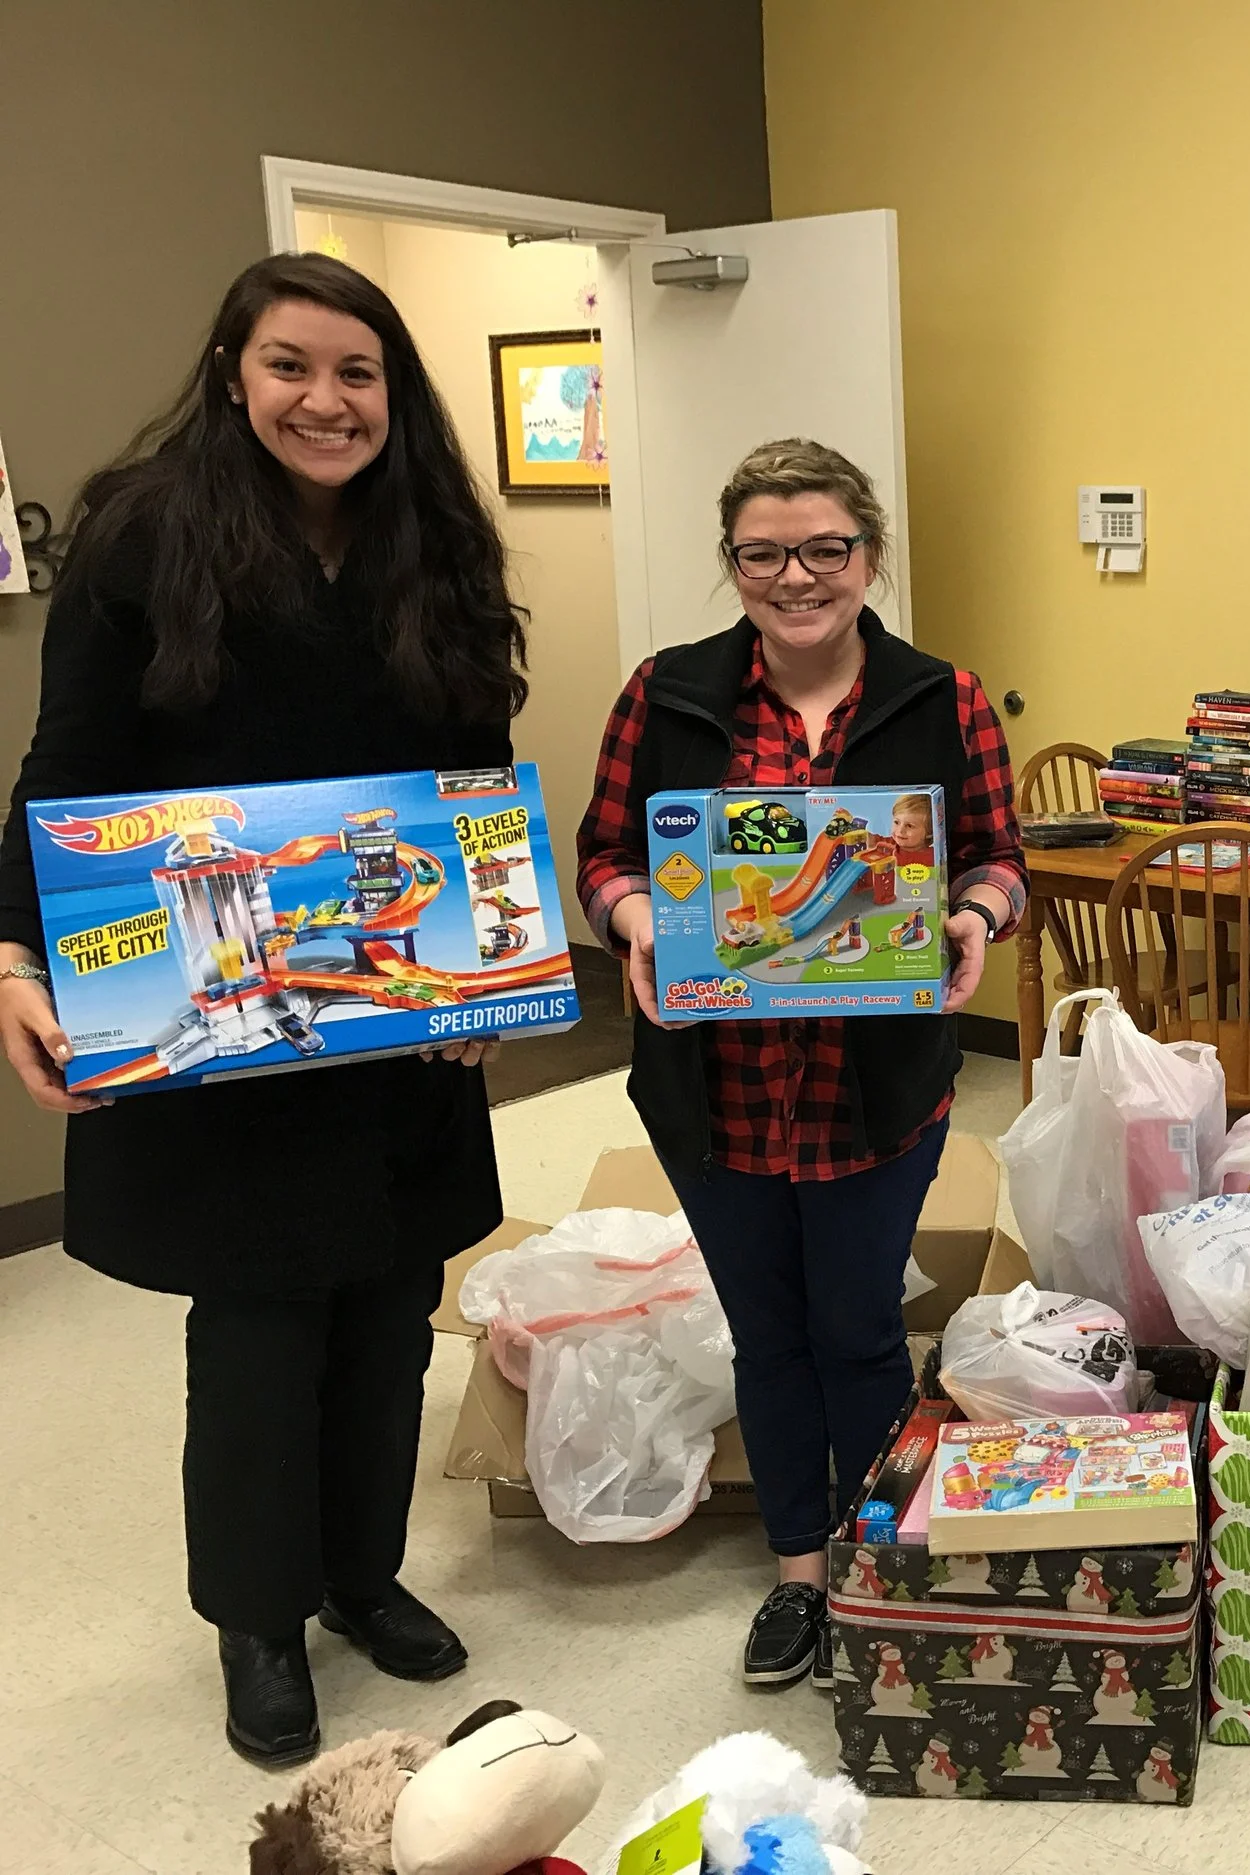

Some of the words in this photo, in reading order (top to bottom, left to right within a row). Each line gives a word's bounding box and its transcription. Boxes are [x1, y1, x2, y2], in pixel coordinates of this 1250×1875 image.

[1207, 696, 1232, 704] HAVEN
[456, 815, 471, 841] 3
[475, 808, 527, 837] LEVELS
[655, 814, 697, 826] vtech
[464, 840, 479, 857] OF
[482, 829, 527, 853] ACTION!
[675, 858, 682, 866] 2
[60, 929, 104, 954] SPEED
[106, 909, 169, 940] THROUGH
[73, 944, 113, 974] THE
[117, 927, 167, 961] CITY!
[664, 994, 704, 1010] Smart
[703, 994, 752, 1009] Wheels
[797, 996, 829, 1007] Launch
[829, 996, 838, 1006] &
[839, 995, 859, 1007] Play
[863, 994, 902, 1006] Raceway
[915, 990, 933, 1000] 1-5
[429, 997, 566, 1036] SPEEDTROPOLIS
[70, 1029, 124, 1042] UNASSEMBLED
[951, 1427, 970, 1441] 5
[970, 1422, 1007, 1433] Wood
[971, 1428, 1021, 1439] Puzzles
[729, 1483, 755, 1494] ANG
[968, 1710, 998, 1726] Bright
